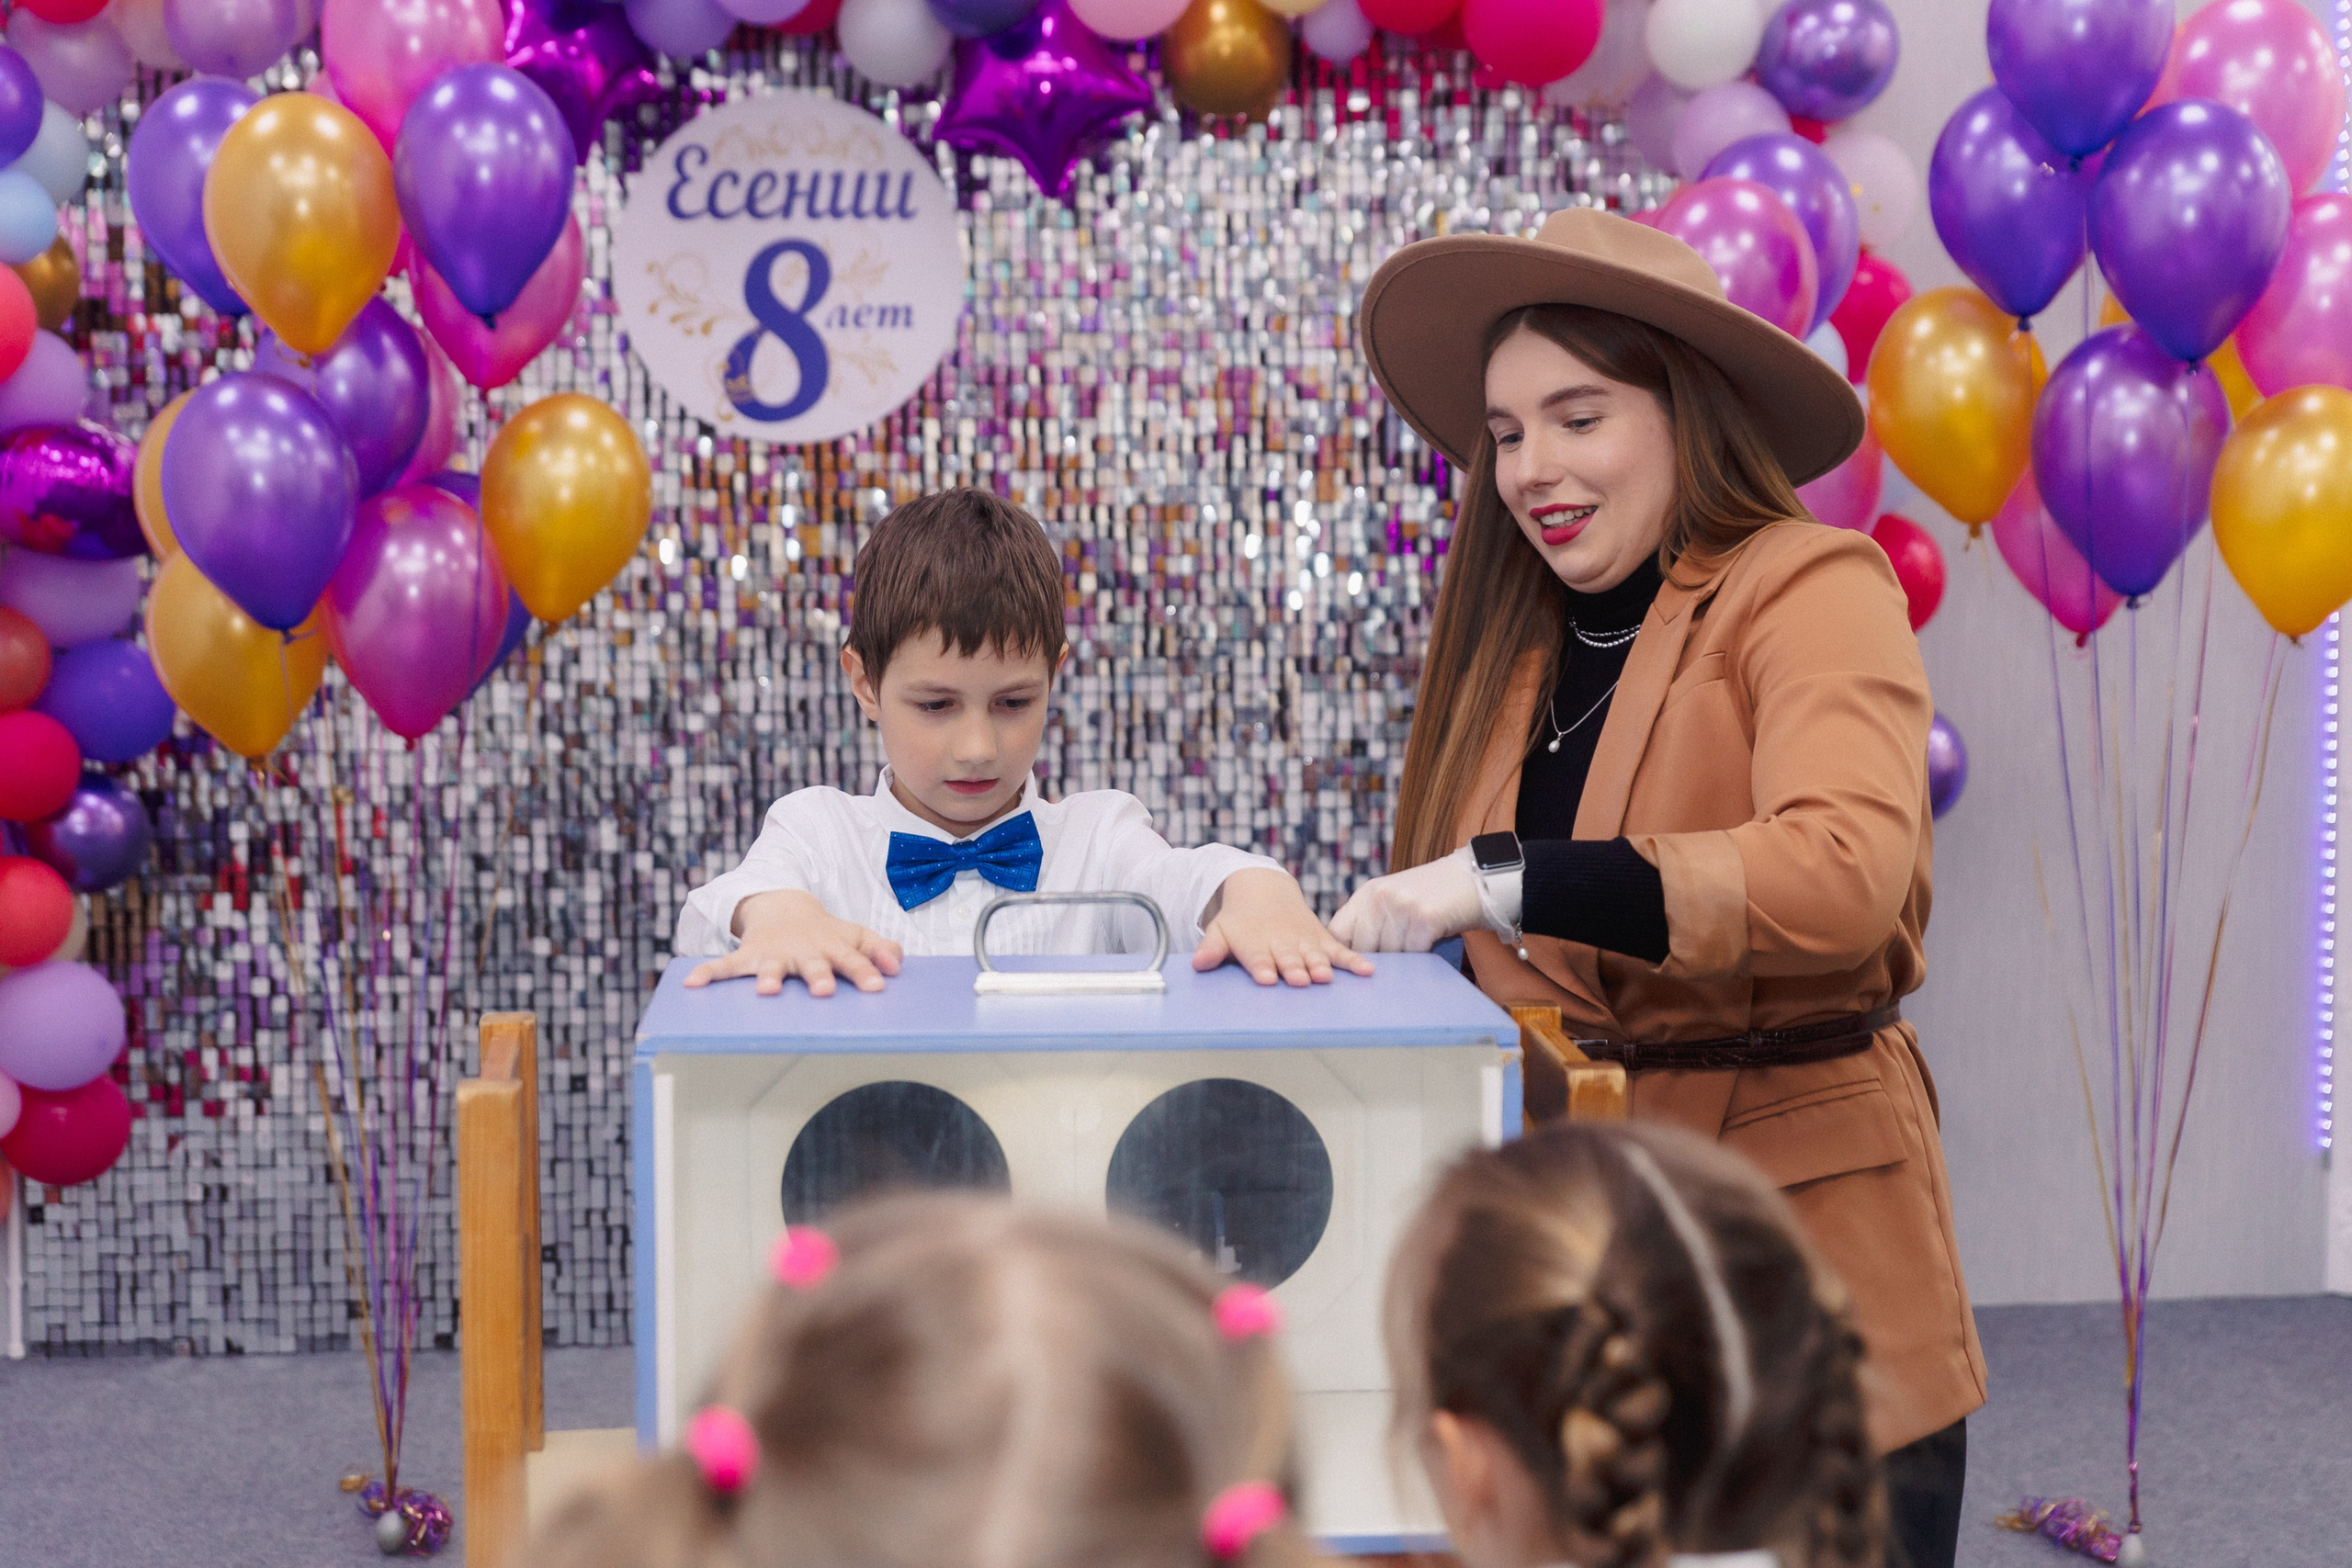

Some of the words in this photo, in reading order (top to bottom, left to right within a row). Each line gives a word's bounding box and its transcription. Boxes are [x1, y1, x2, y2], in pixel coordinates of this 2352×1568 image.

[666, 143, 918, 220] Есении
[723, 238, 832, 423] 8
[828, 303, 913, 329] лет
